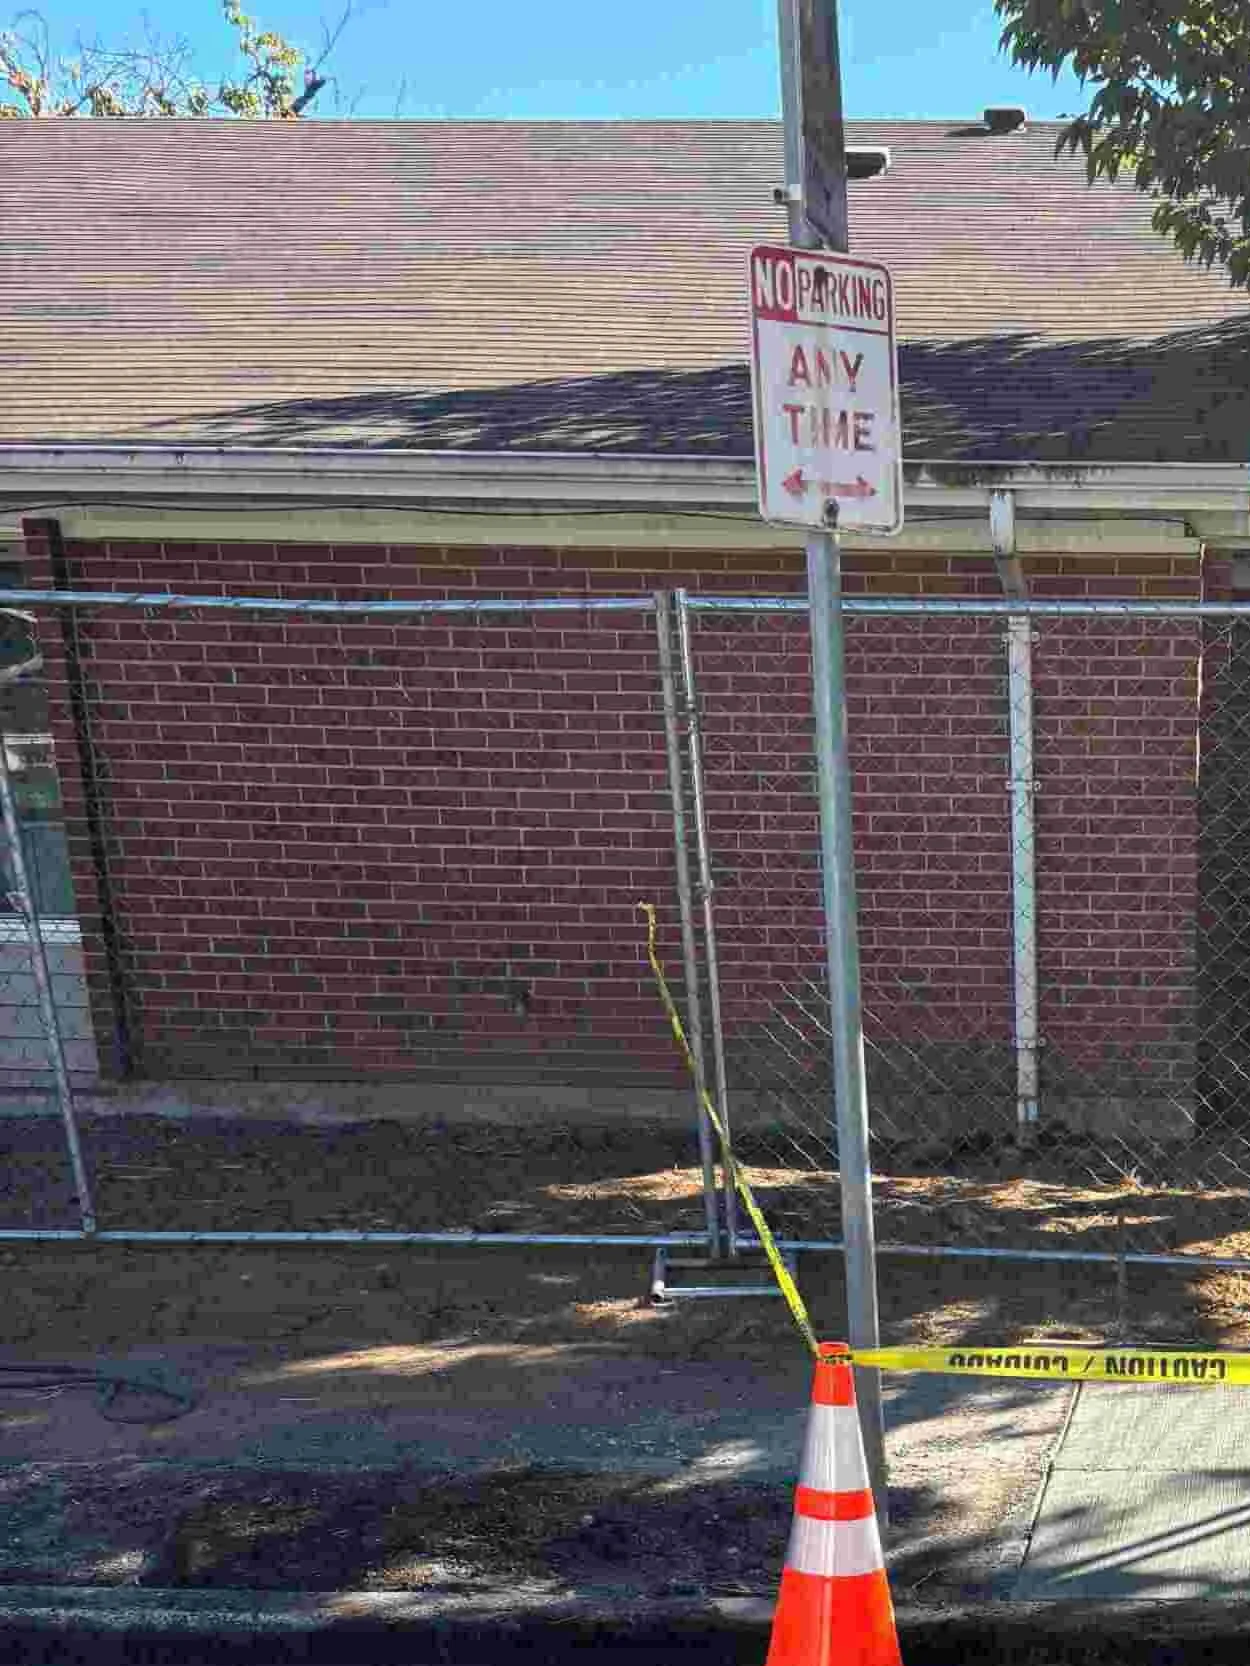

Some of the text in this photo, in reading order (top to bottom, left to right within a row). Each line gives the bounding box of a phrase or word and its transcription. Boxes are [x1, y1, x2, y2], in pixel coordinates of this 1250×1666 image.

[754, 256, 885, 320] NO PARKING
[788, 345, 863, 392] ANY
[783, 404, 875, 451] TIME
[1105, 1355, 1226, 1380] CAUTION
